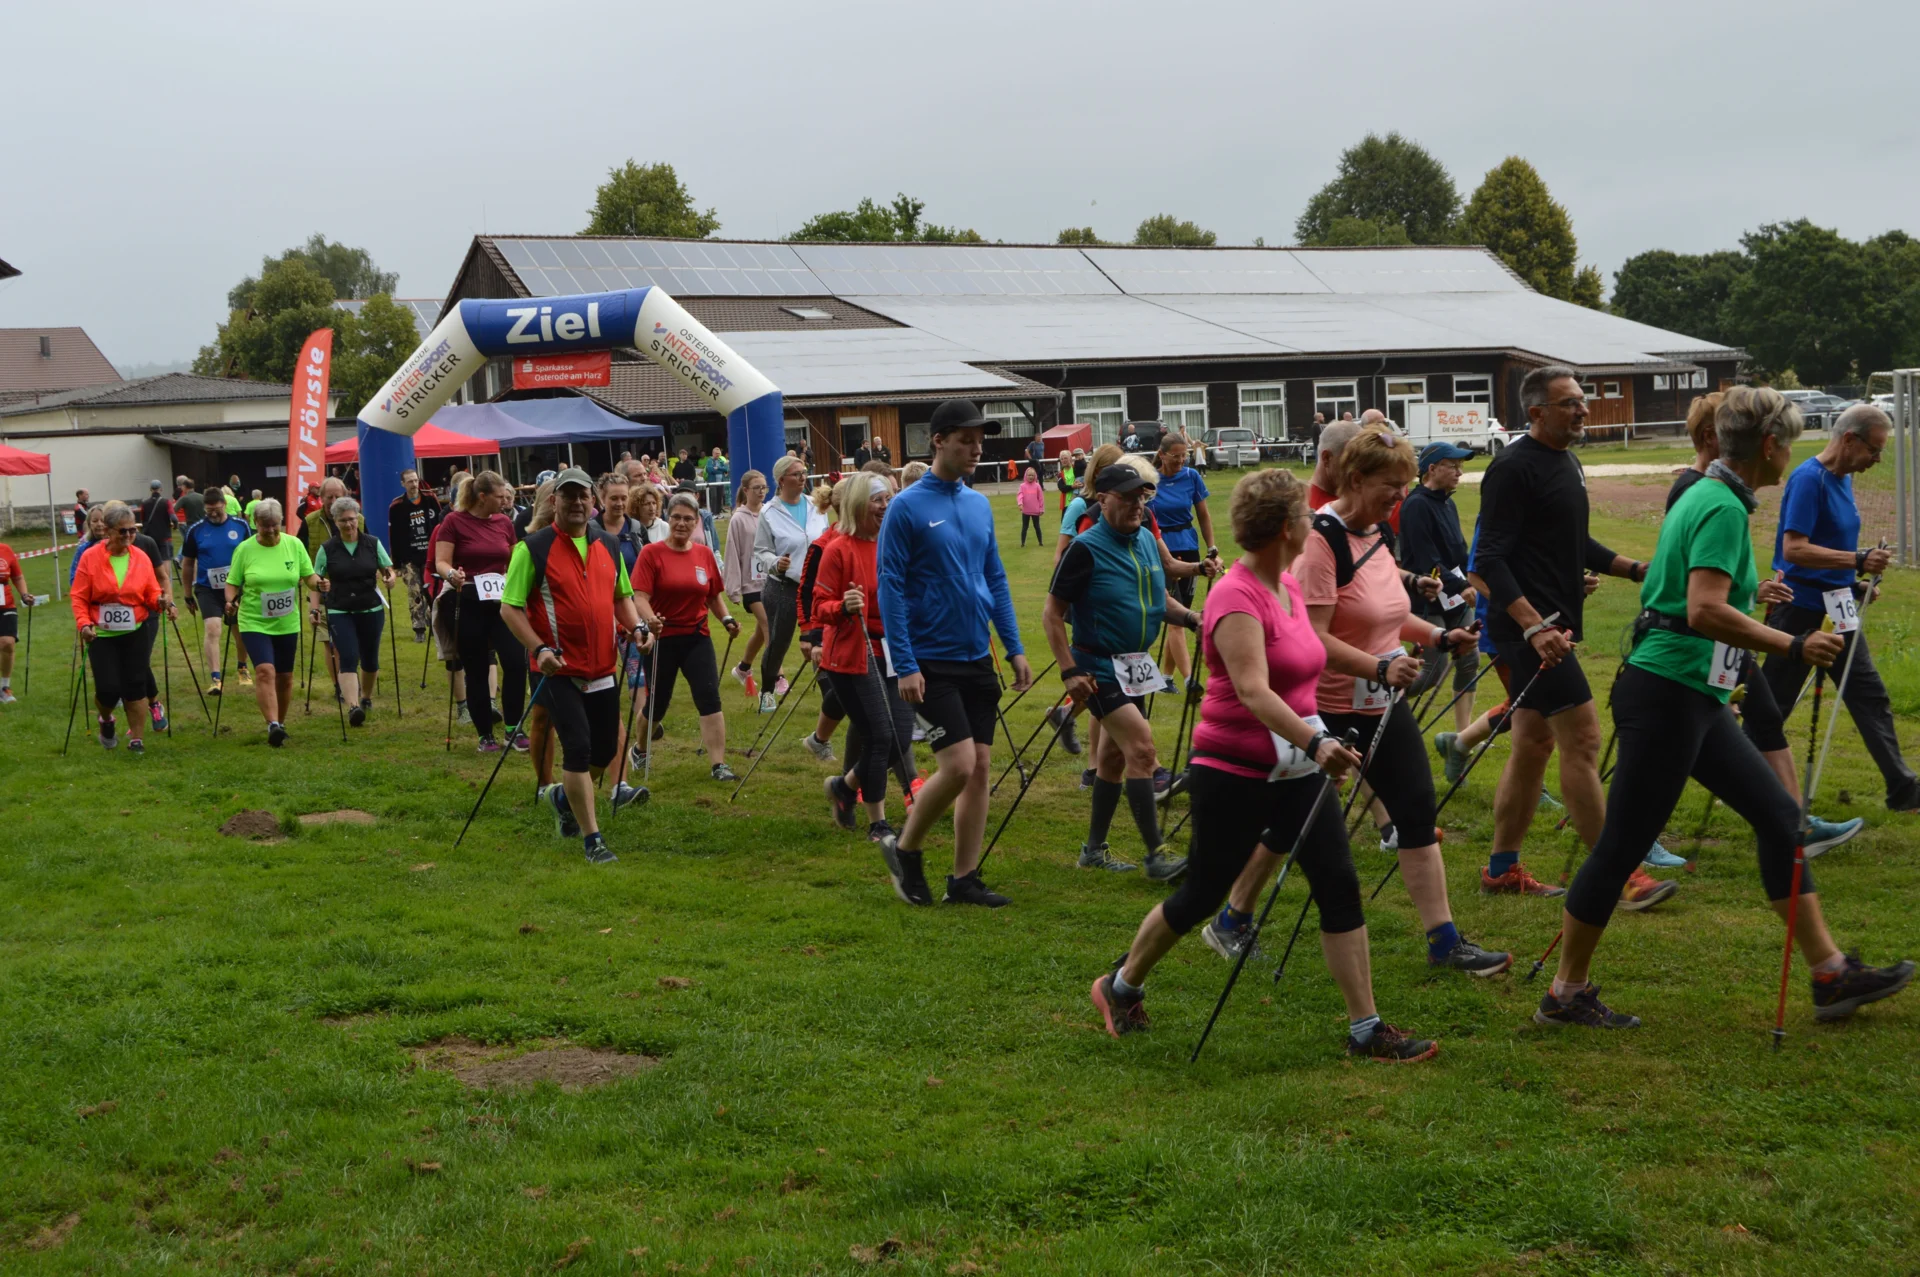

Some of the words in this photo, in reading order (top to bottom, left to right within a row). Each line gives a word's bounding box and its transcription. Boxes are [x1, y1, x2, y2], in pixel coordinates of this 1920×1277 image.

[506, 302, 601, 344] Ziel
[391, 345, 429, 387] OSTERODE
[664, 332, 733, 391] INTERSPORT
[680, 328, 727, 368] OSTERODE
[391, 338, 452, 404] INTERSPORT
[396, 353, 462, 419] STRICKER
[534, 373, 569, 382] Osterode
[584, 371, 602, 380] Harz
[535, 364, 574, 373] Sparkasse
[650, 339, 720, 400] STRICKER
[300, 347, 324, 447] Förste
[1437, 410, 1464, 425] Rex
[104, 610, 131, 623] 082
[267, 596, 292, 611] 085
[1835, 600, 1858, 619] 16
[1124, 662, 1154, 685] 132
